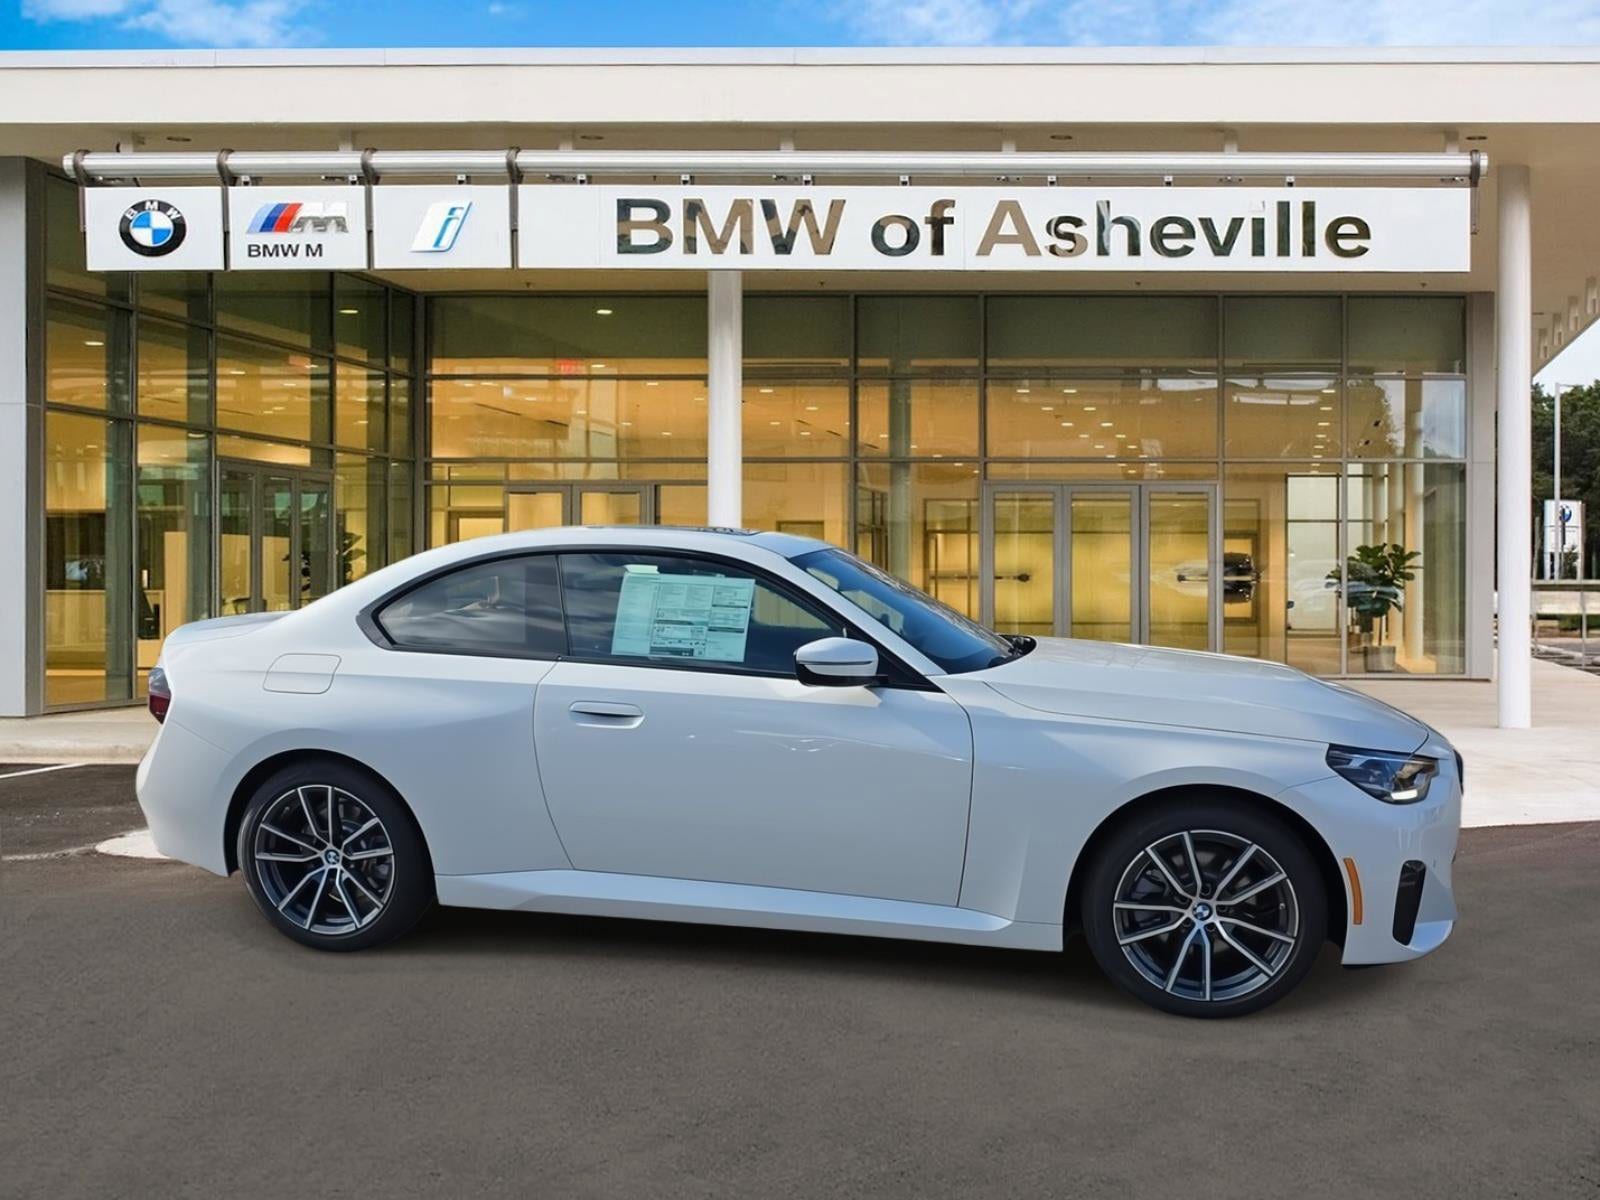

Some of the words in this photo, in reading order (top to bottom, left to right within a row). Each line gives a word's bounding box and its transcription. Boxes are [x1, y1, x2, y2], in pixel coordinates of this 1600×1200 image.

[124, 201, 181, 220] BMW
[616, 198, 846, 256] BMW
[870, 199, 956, 257] of
[975, 199, 1372, 258] Asheville
[247, 243, 300, 258] BMW
[305, 243, 323, 258] M
